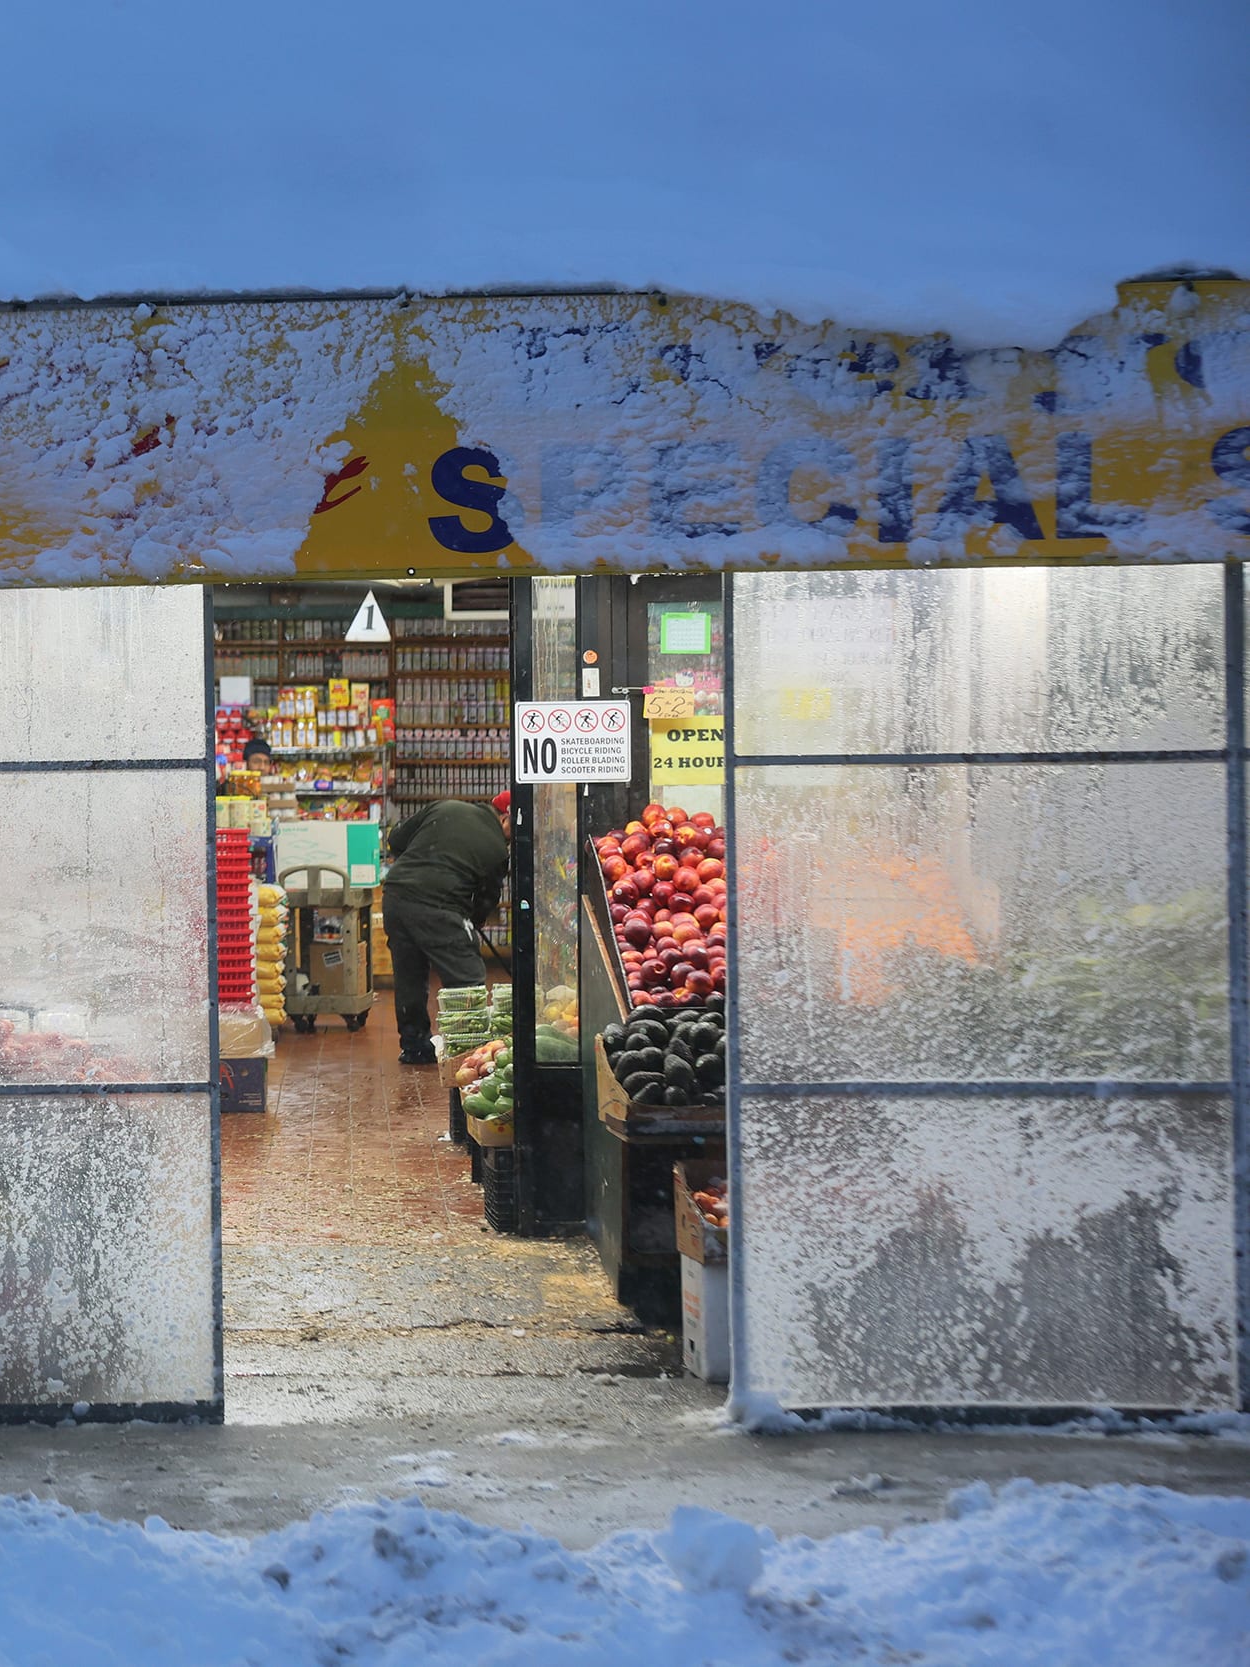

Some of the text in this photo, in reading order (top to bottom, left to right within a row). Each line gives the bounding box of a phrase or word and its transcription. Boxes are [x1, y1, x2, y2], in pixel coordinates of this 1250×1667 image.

[363, 604, 376, 631] 1
[667, 728, 724, 742] OPEN
[561, 737, 625, 745] SKATEBOARDING
[523, 737, 557, 774] NO
[561, 747, 592, 755] BICYCLE
[561, 756, 590, 764] ROLLER
[654, 757, 673, 768] 24
[561, 766, 596, 774] SCOOTER
